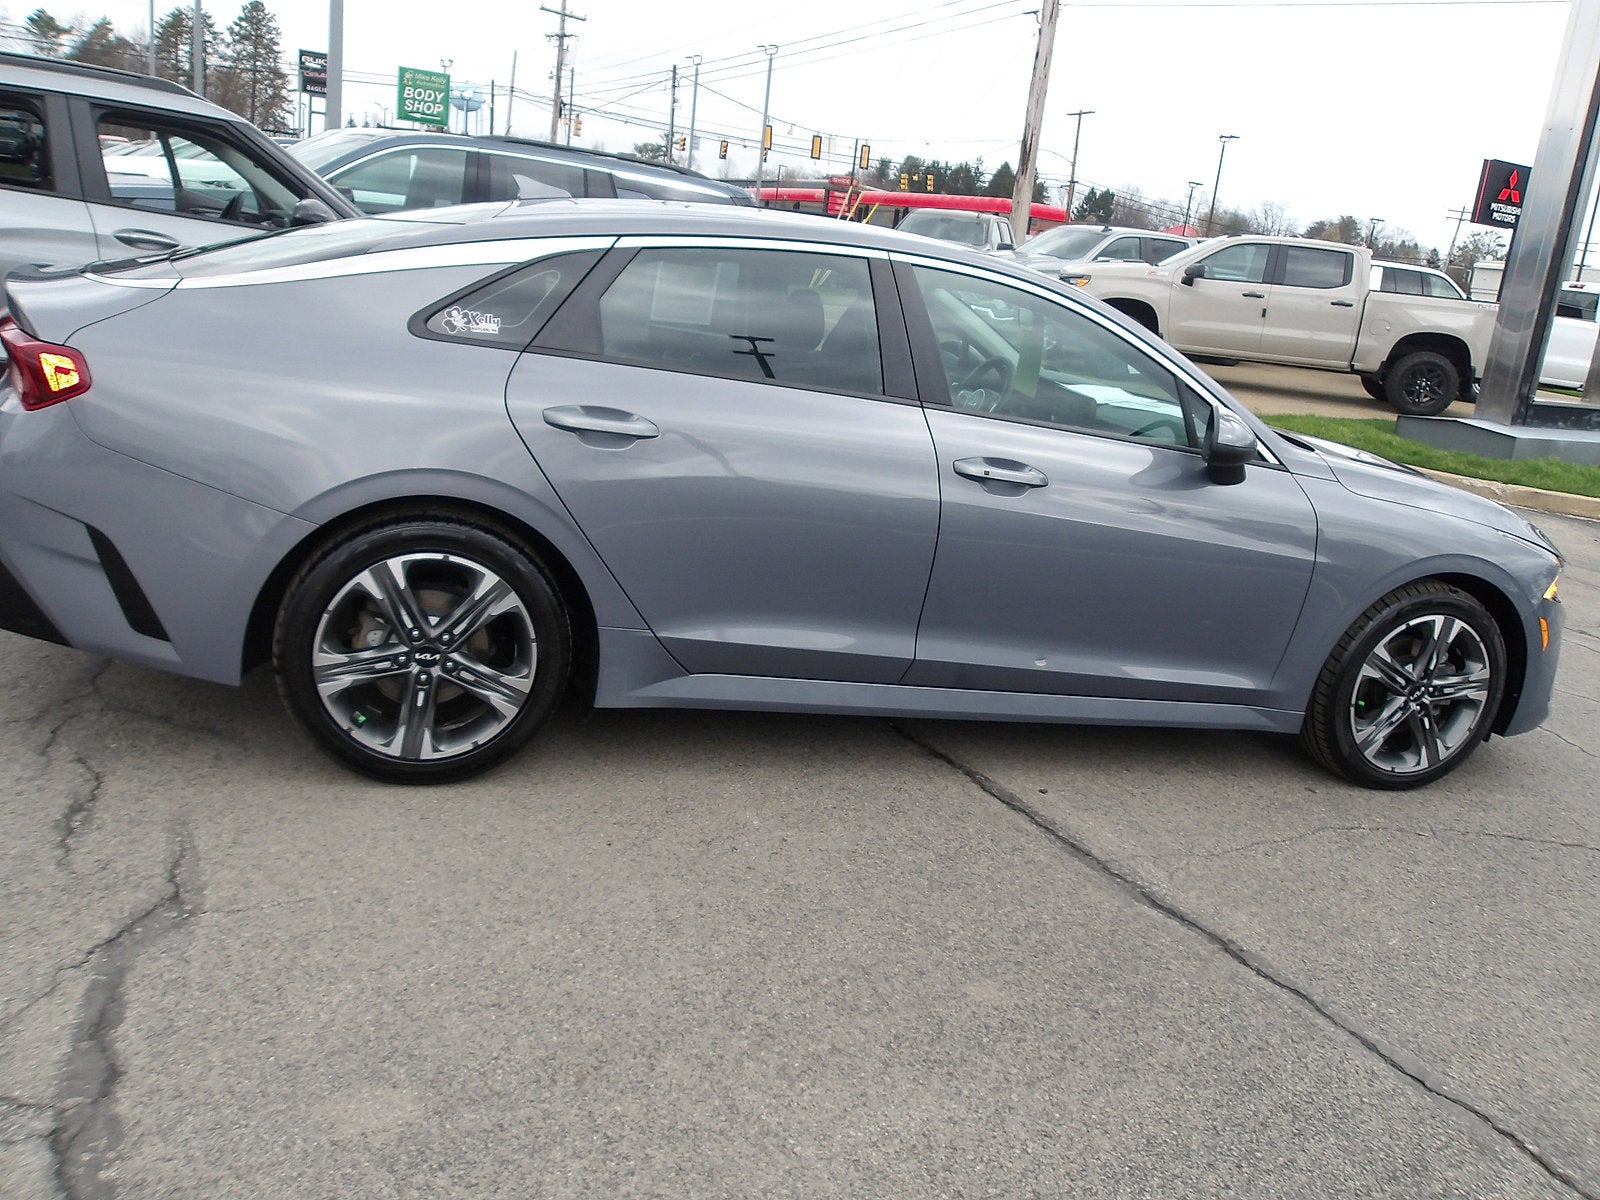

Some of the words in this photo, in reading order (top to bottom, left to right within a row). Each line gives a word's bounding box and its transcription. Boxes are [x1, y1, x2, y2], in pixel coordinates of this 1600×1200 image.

[301, 55, 327, 66] BUIC
[431, 75, 446, 85] Kelly
[403, 86, 444, 102] BODY
[403, 99, 443, 114] SHOP
[831, 177, 858, 186] SHEEZ
[1492, 212, 1516, 223] MOTORS
[469, 311, 501, 328] Kelly
